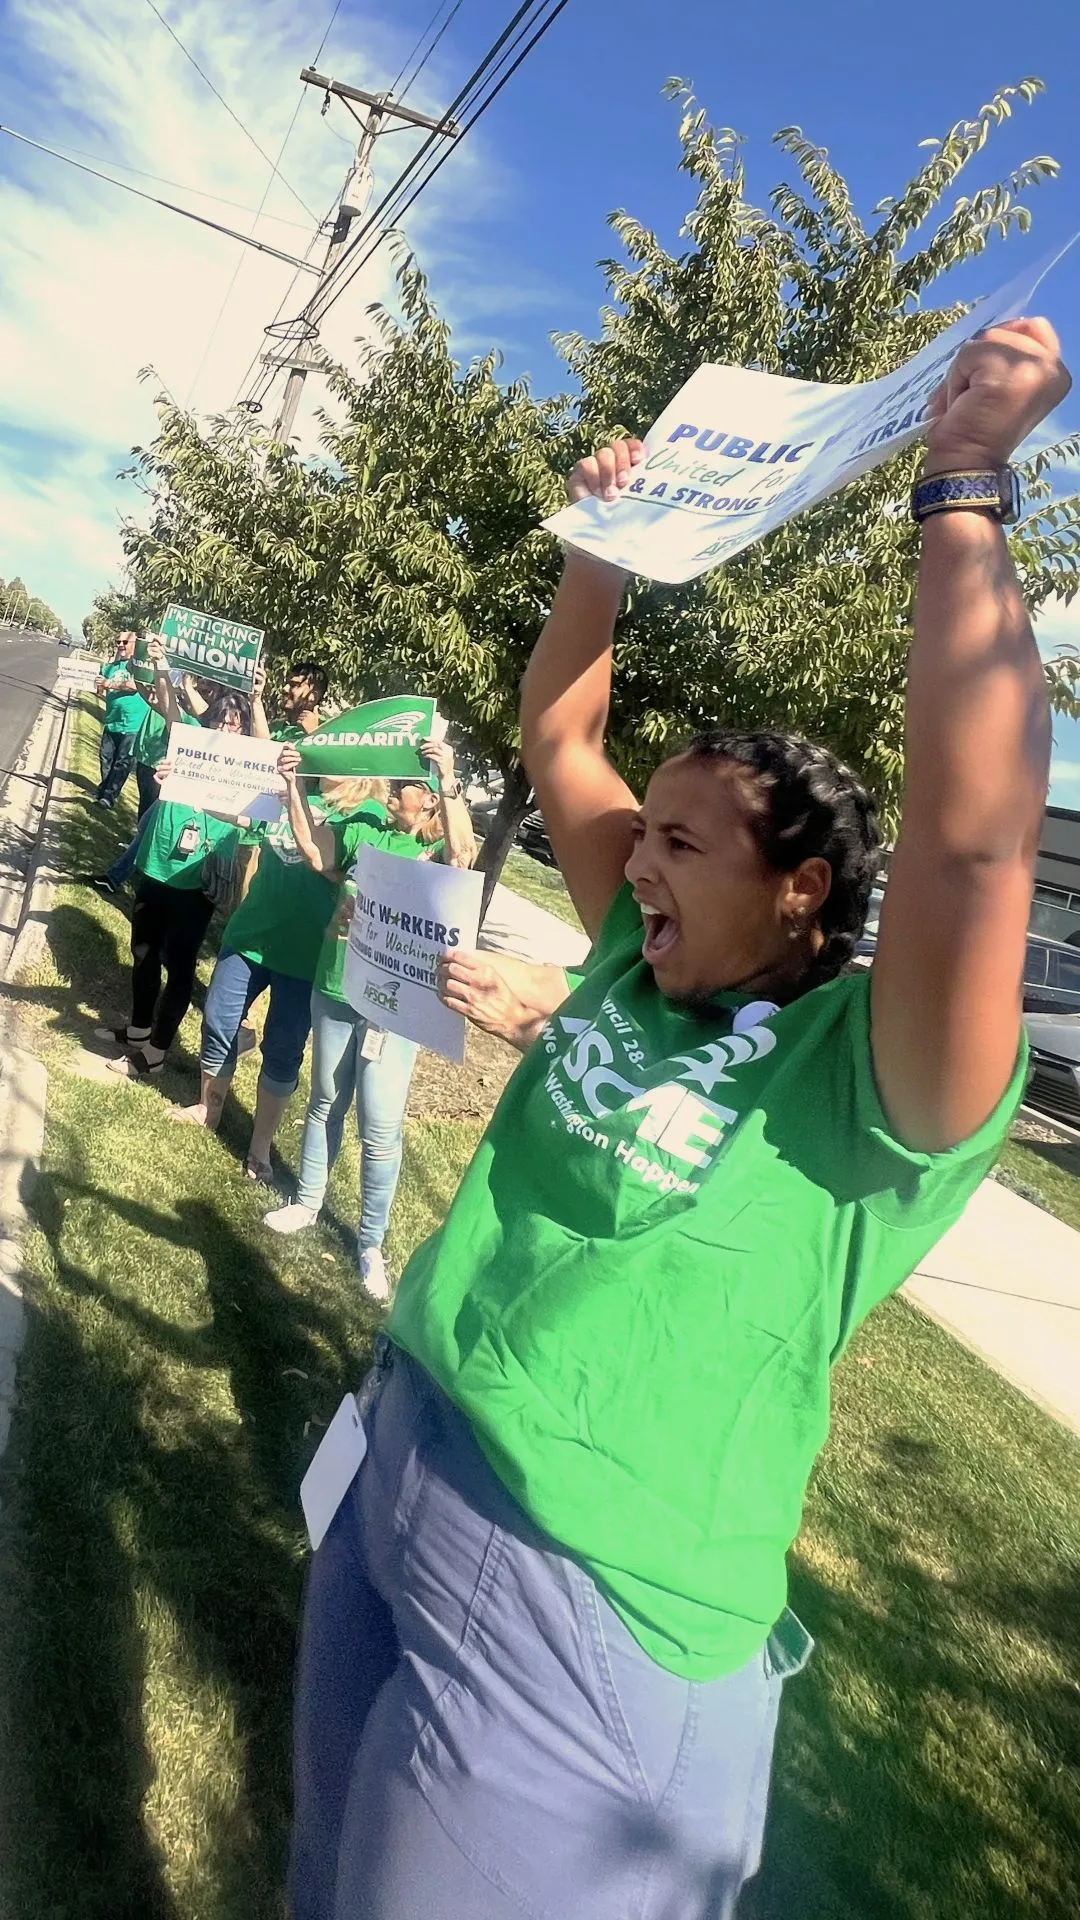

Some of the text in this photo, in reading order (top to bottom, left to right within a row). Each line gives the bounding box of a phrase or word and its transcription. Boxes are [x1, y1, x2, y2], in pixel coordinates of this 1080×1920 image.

[667, 423, 815, 464] PUBLIC
[645, 448, 746, 487] United
[749, 468, 797, 493] for
[628, 477, 646, 494] &
[648, 482, 669, 498] A
[671, 487, 762, 512] STRONG
[168, 607, 260, 645] I'M STICKING
[177, 623, 245, 654] WITH MY
[165, 633, 256, 678] UNION!
[301, 731, 421, 747] SOLIDARITY
[177, 747, 278, 774] PUBLIC WRKER
[187, 770, 216, 782] STRONG
[217, 777, 241, 788] UNION
[365, 921, 378, 941] for
[373, 950, 400, 972] UNION
[402, 963, 438, 986] CONTR
[363, 984, 399, 1012] AFSCME
[544, 1072, 610, 1150] Washington
